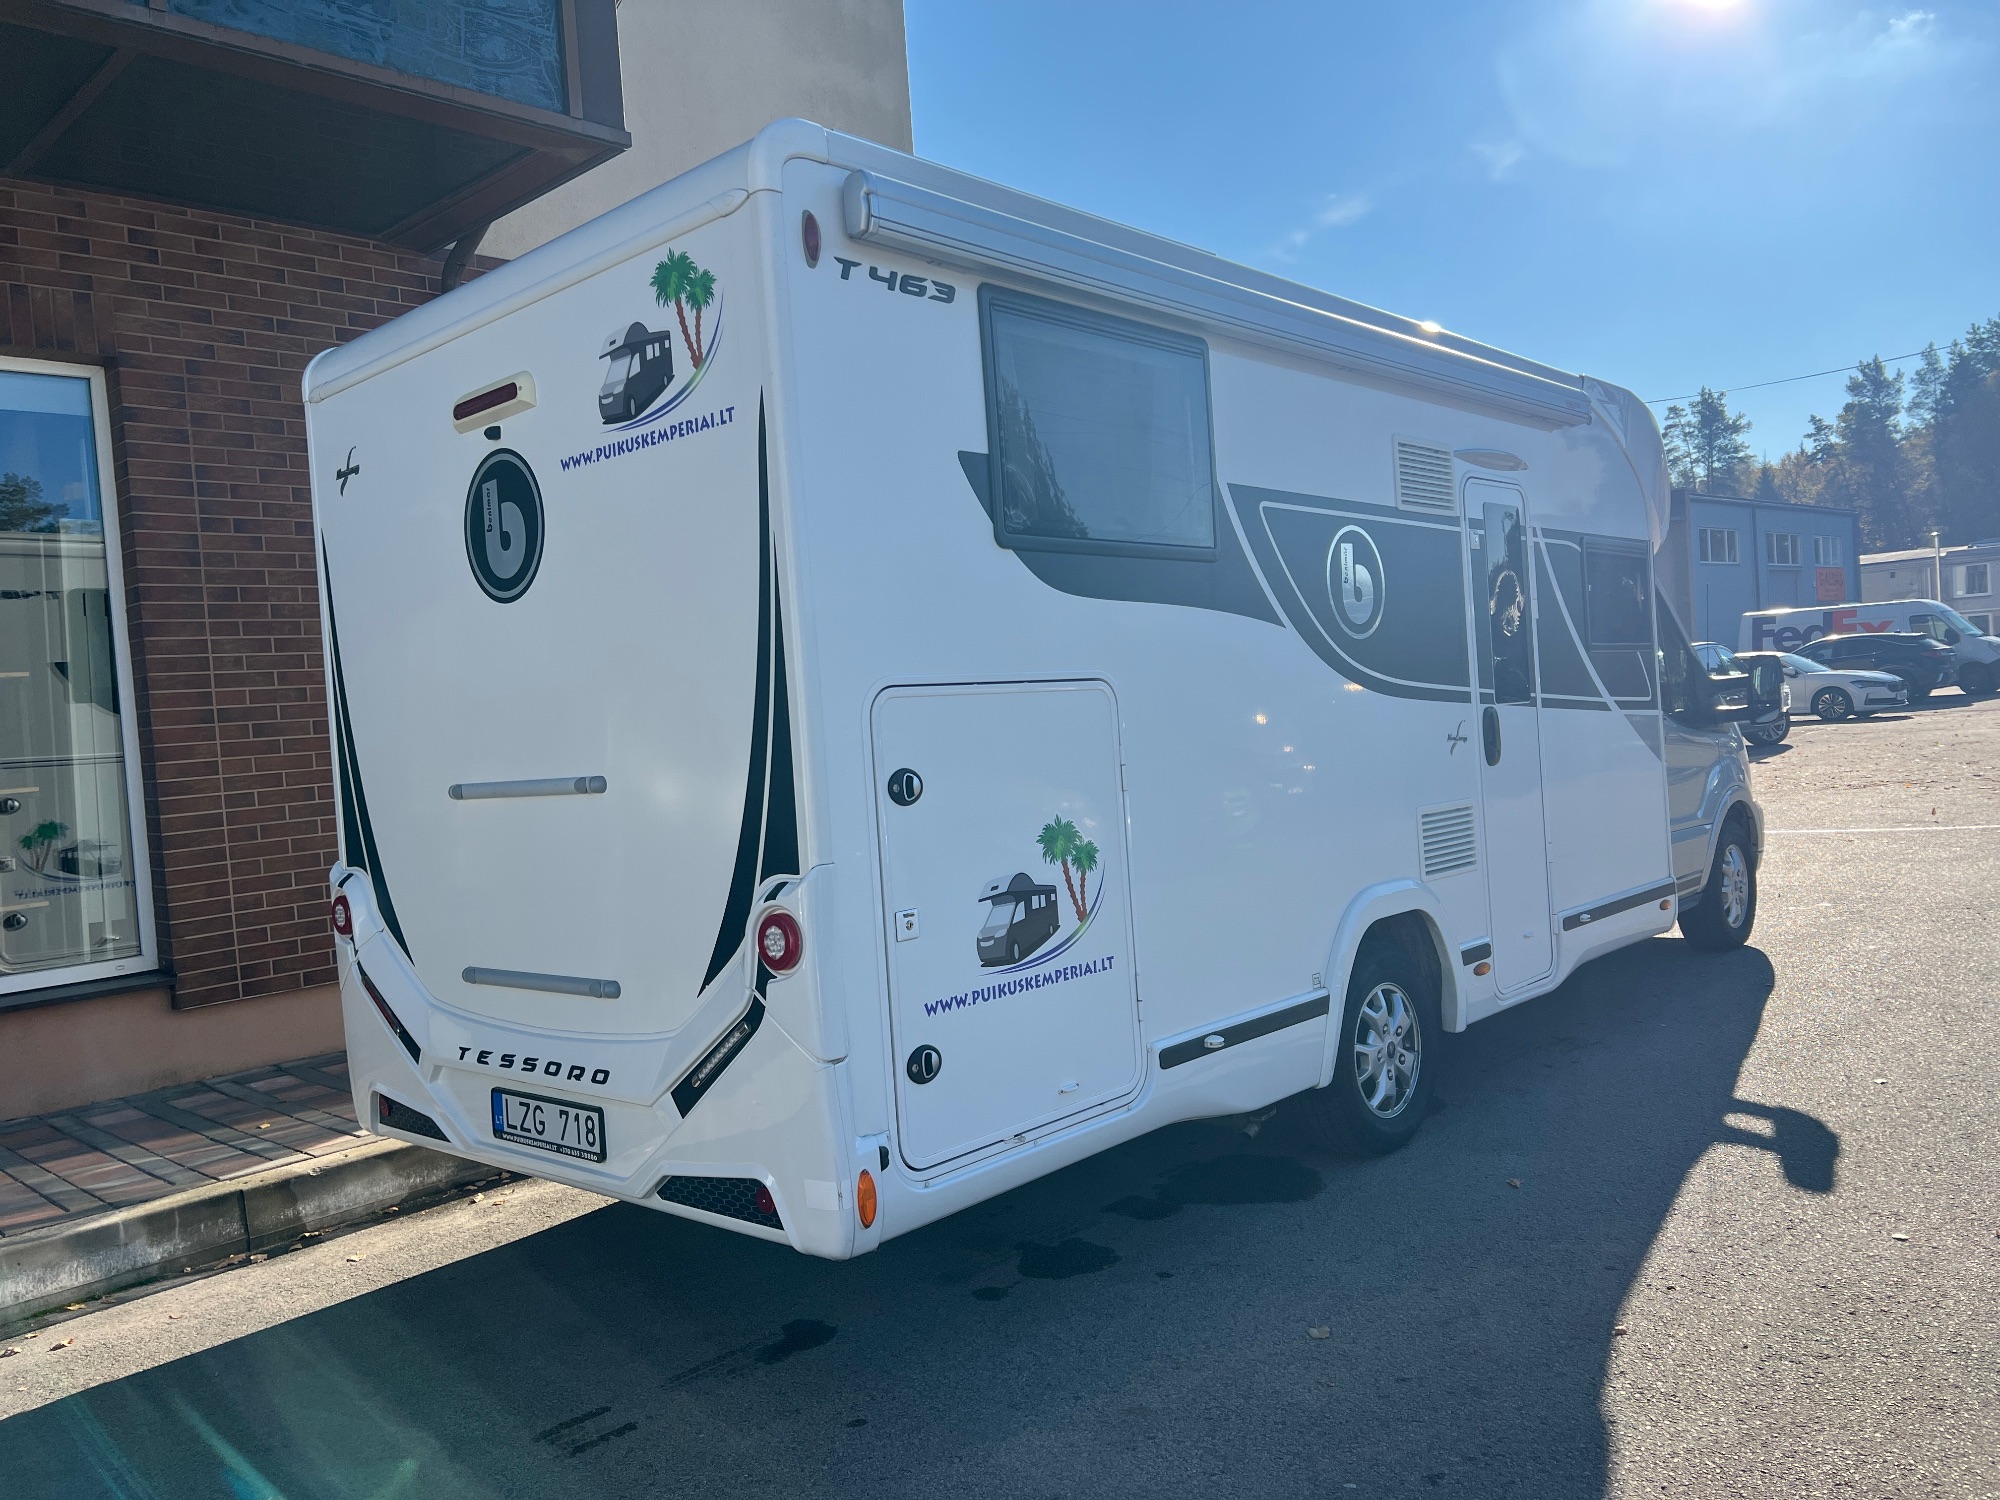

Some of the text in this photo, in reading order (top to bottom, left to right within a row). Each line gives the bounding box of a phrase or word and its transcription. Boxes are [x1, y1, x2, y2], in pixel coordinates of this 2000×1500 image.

[833, 256, 956, 304] T 463
[560, 406, 735, 472] WWW.PUIKUSKEMPERIAI.LT
[924, 955, 1115, 1018] WWW.PUIKUSKEMPERIAI.LT
[458, 1046, 611, 1085] TESSORO
[495, 1115, 503, 1125] LT
[505, 1098, 597, 1147] LZG 718
